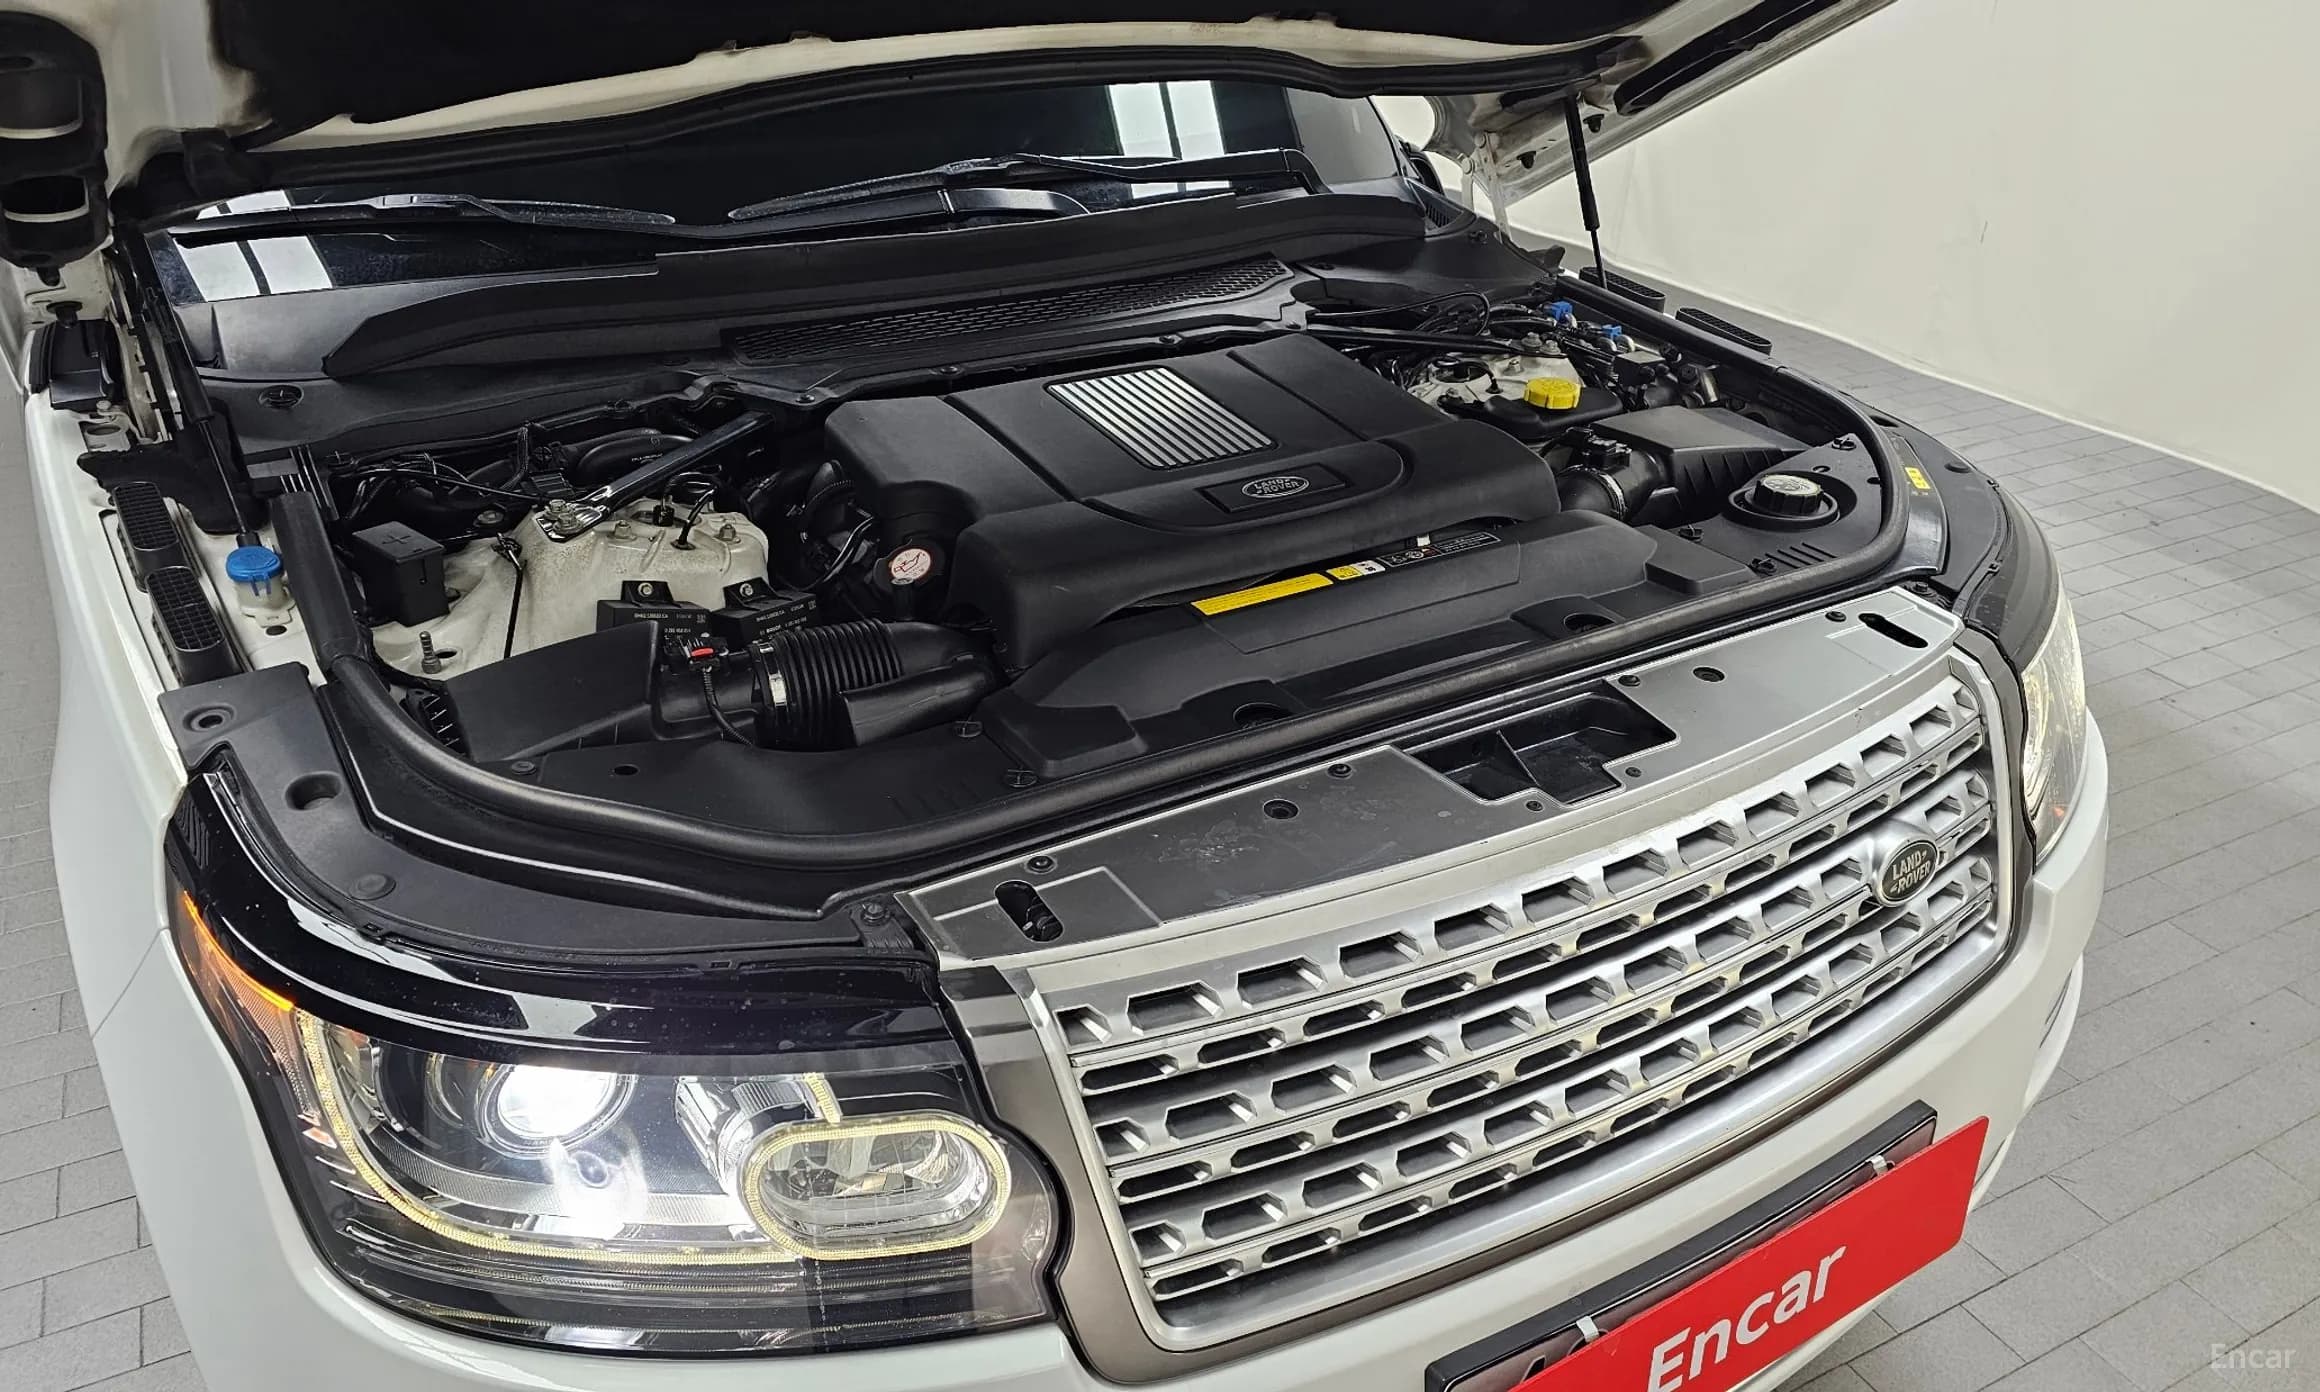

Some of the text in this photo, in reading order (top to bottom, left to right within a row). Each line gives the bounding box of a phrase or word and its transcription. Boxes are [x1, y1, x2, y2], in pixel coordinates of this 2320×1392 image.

[1253, 479, 1284, 489] LAND
[1262, 481, 1300, 494] ROVER
[1892, 850, 1922, 880] LAND
[1897, 861, 1931, 894] ROVER
[1647, 1246, 1847, 1392] Encar
